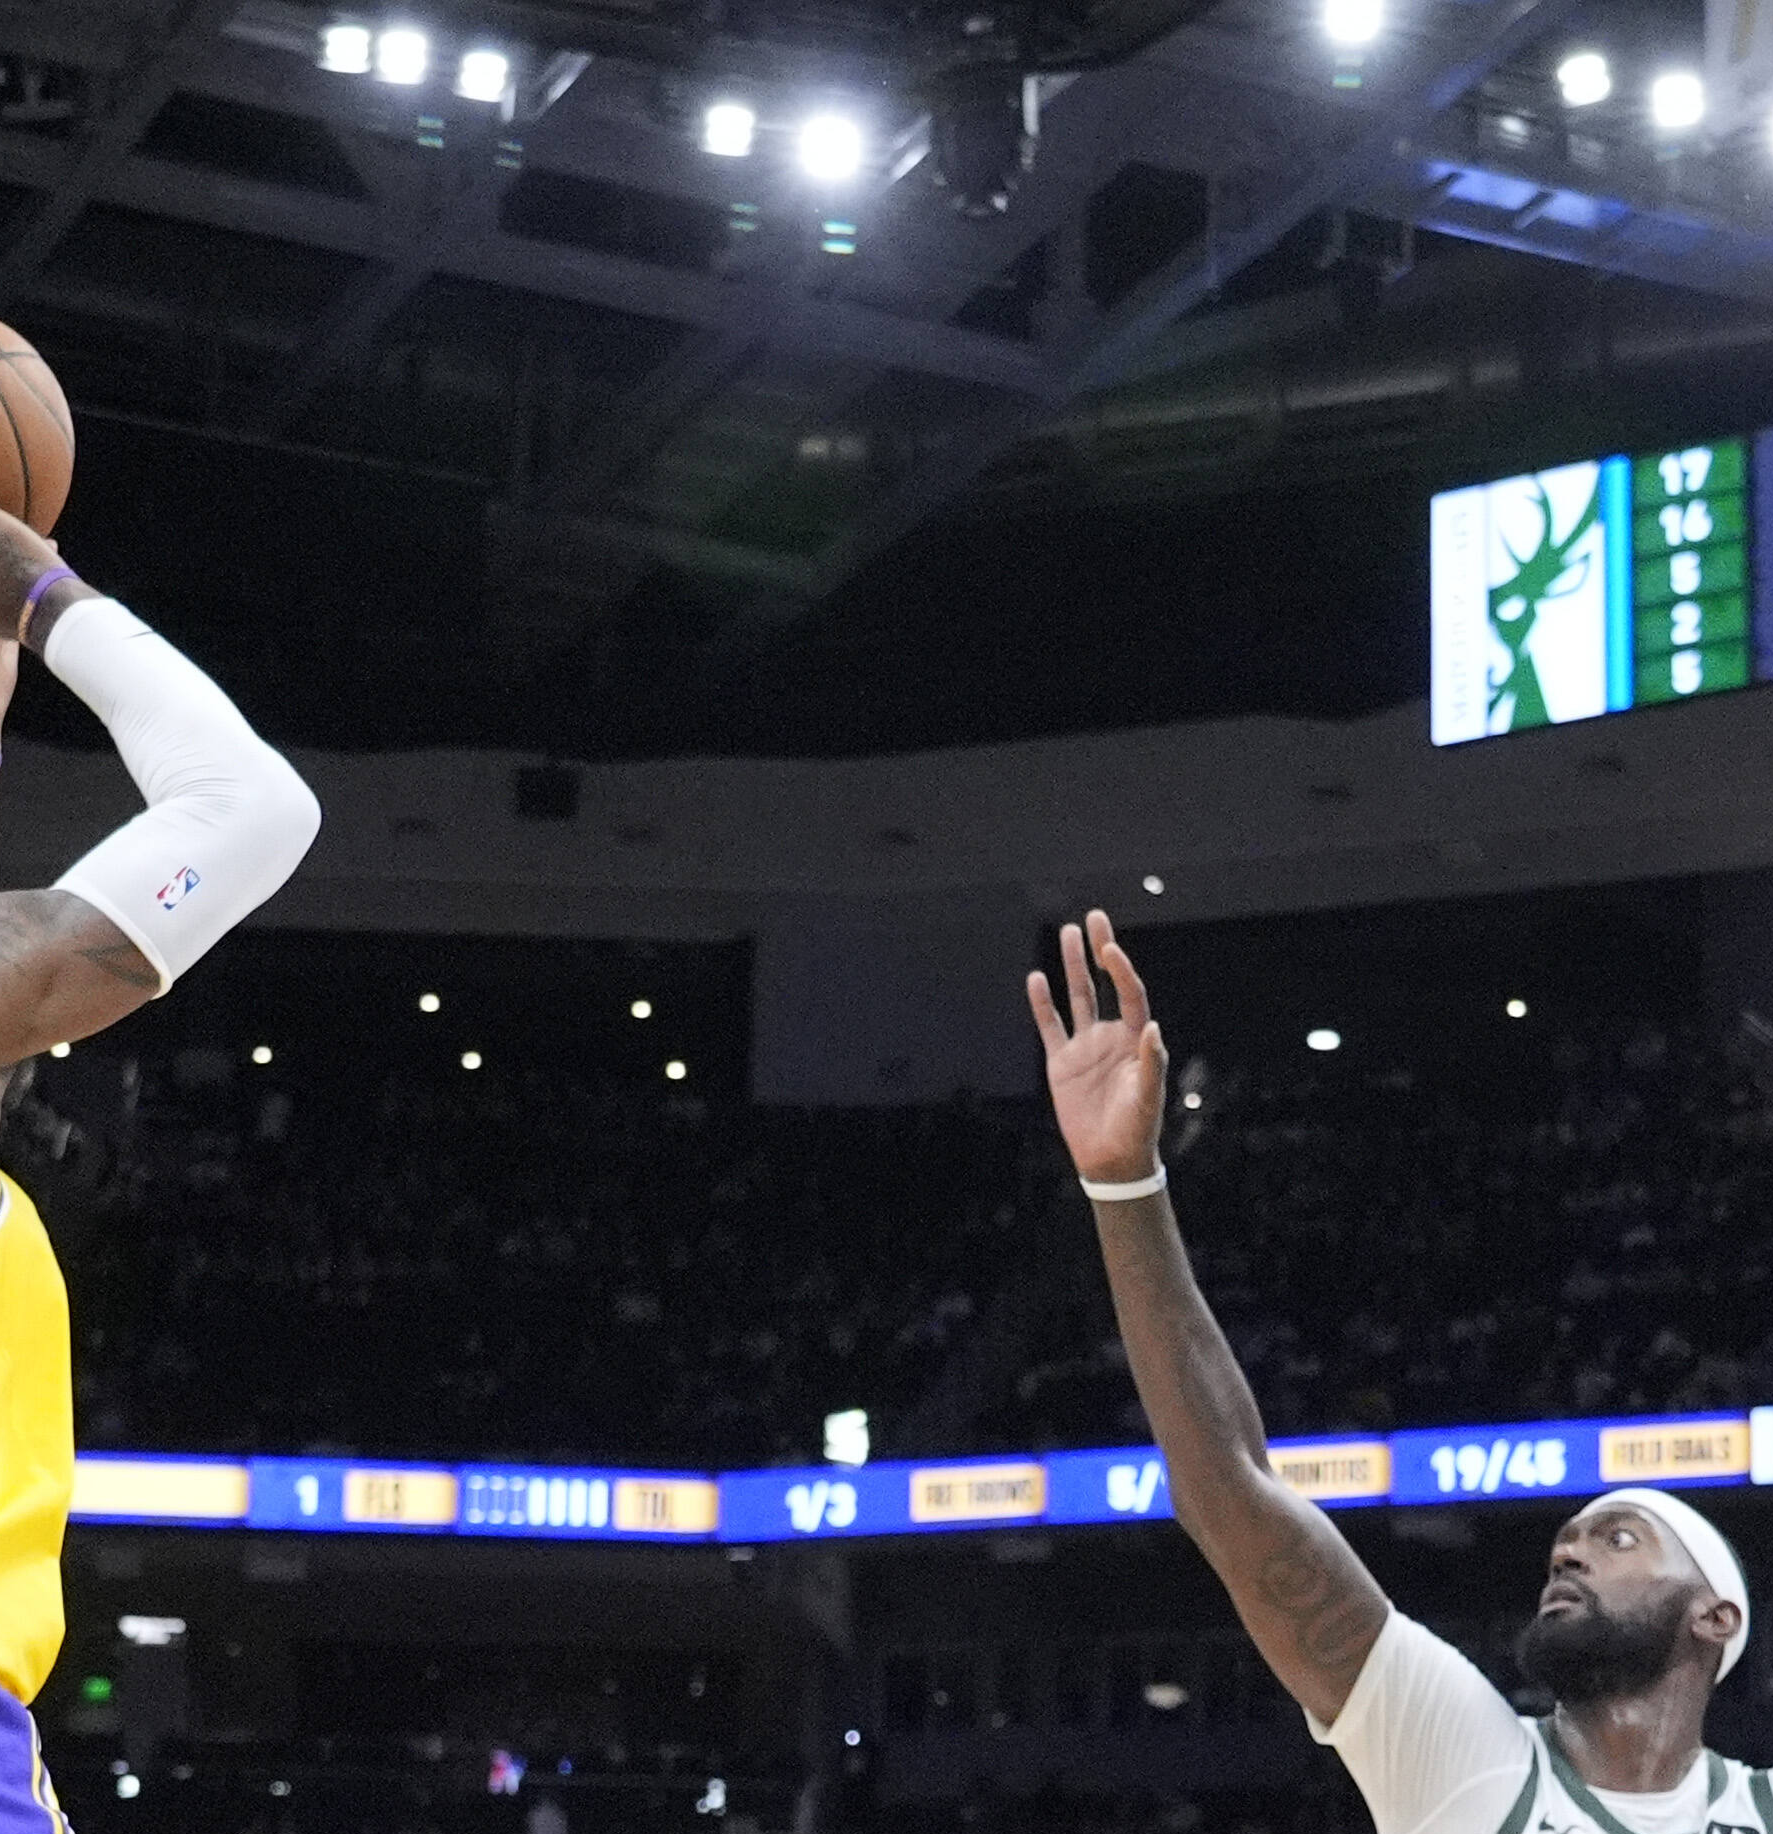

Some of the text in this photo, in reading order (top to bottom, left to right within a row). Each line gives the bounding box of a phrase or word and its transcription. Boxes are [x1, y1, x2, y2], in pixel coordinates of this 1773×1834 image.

[1658, 447, 1713, 496] 17
[1658, 498, 1714, 547] 16
[1669, 550, 1701, 595] 5
[1670, 601, 1702, 646] 2
[1670, 650, 1704, 695] 5
[295, 1475, 320, 1518] 1
[784, 1480, 858, 1533] 1/3
[1430, 1439, 1567, 1494] 19/45
